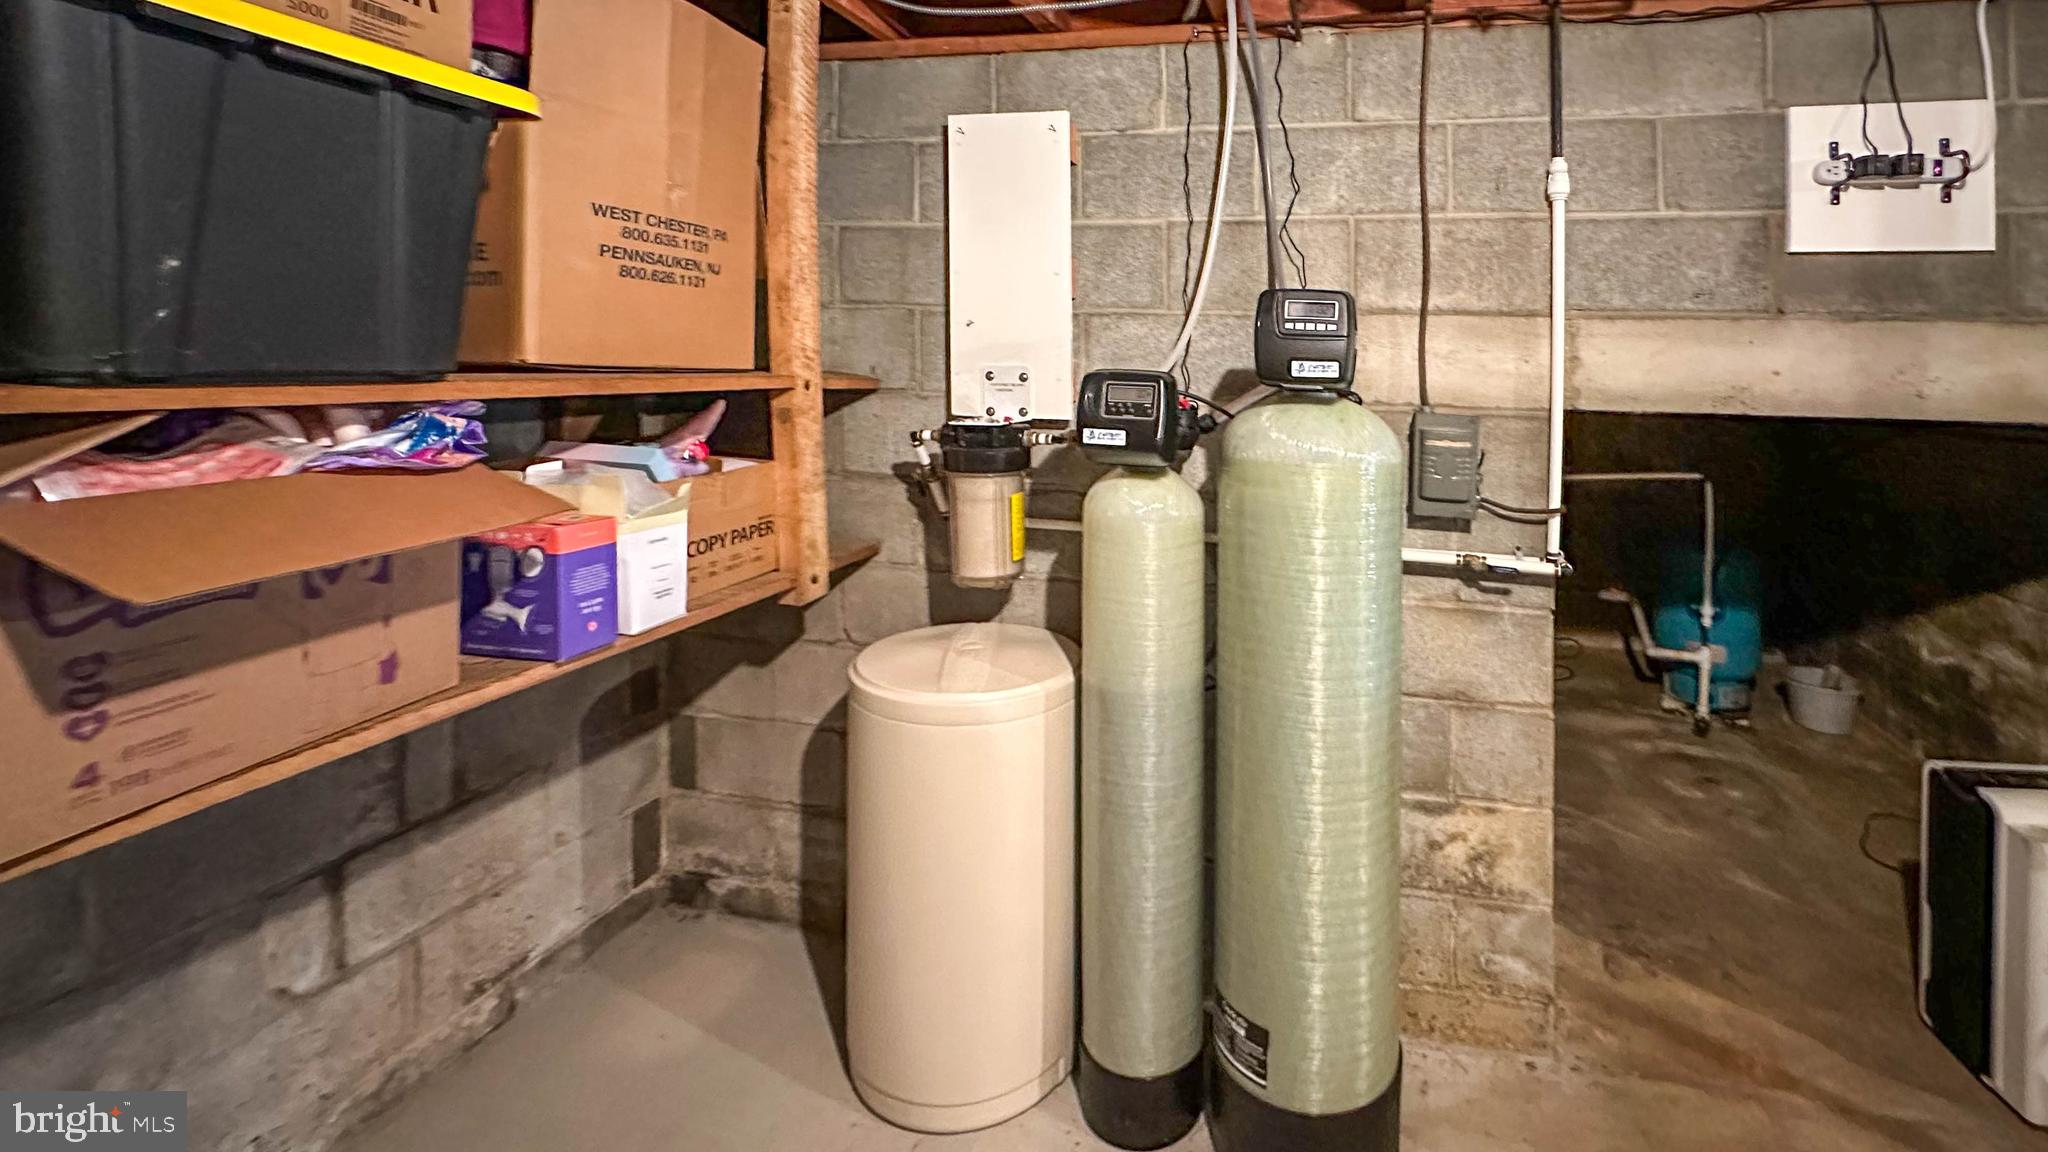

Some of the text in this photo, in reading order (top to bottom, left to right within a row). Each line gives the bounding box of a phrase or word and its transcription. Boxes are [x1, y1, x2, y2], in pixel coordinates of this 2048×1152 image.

[591, 202, 642, 224] WEST
[687, 520, 775, 558] COPY PAPER
